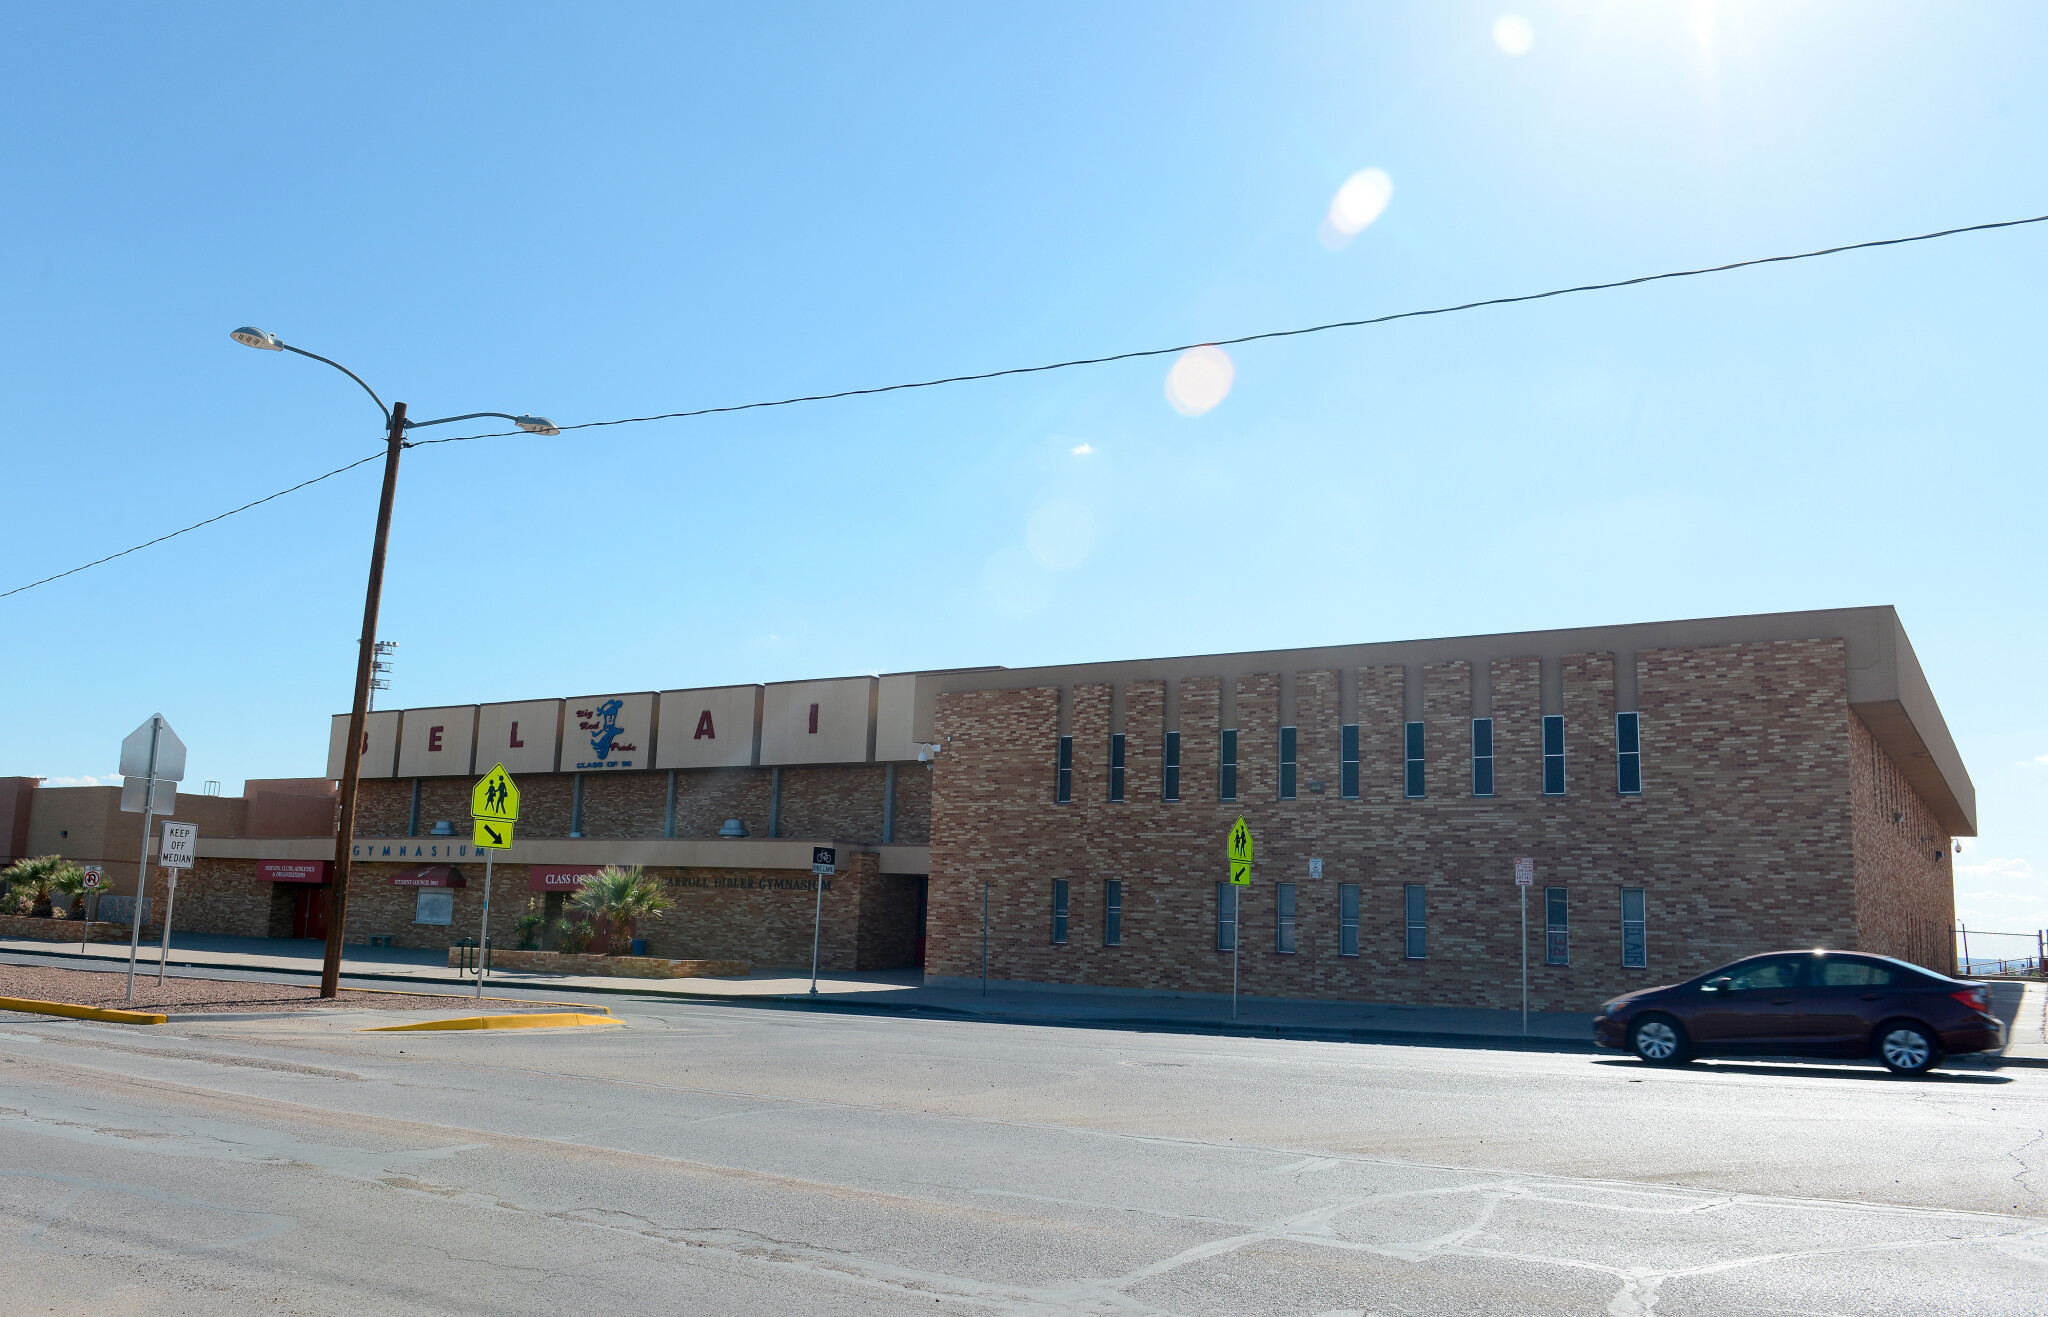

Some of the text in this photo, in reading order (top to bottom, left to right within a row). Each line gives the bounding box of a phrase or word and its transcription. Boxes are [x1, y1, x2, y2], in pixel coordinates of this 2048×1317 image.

[576, 709, 593, 719] Big
[579, 721, 600, 730] Red
[576, 761, 603, 769] CLASS
[170, 828, 190, 838] KEEP
[171, 841, 186, 850] OFF
[353, 845, 485, 856] GYMNASIUM
[162, 853, 191, 863] MEDIAN
[545, 874, 571, 884] CLASS
